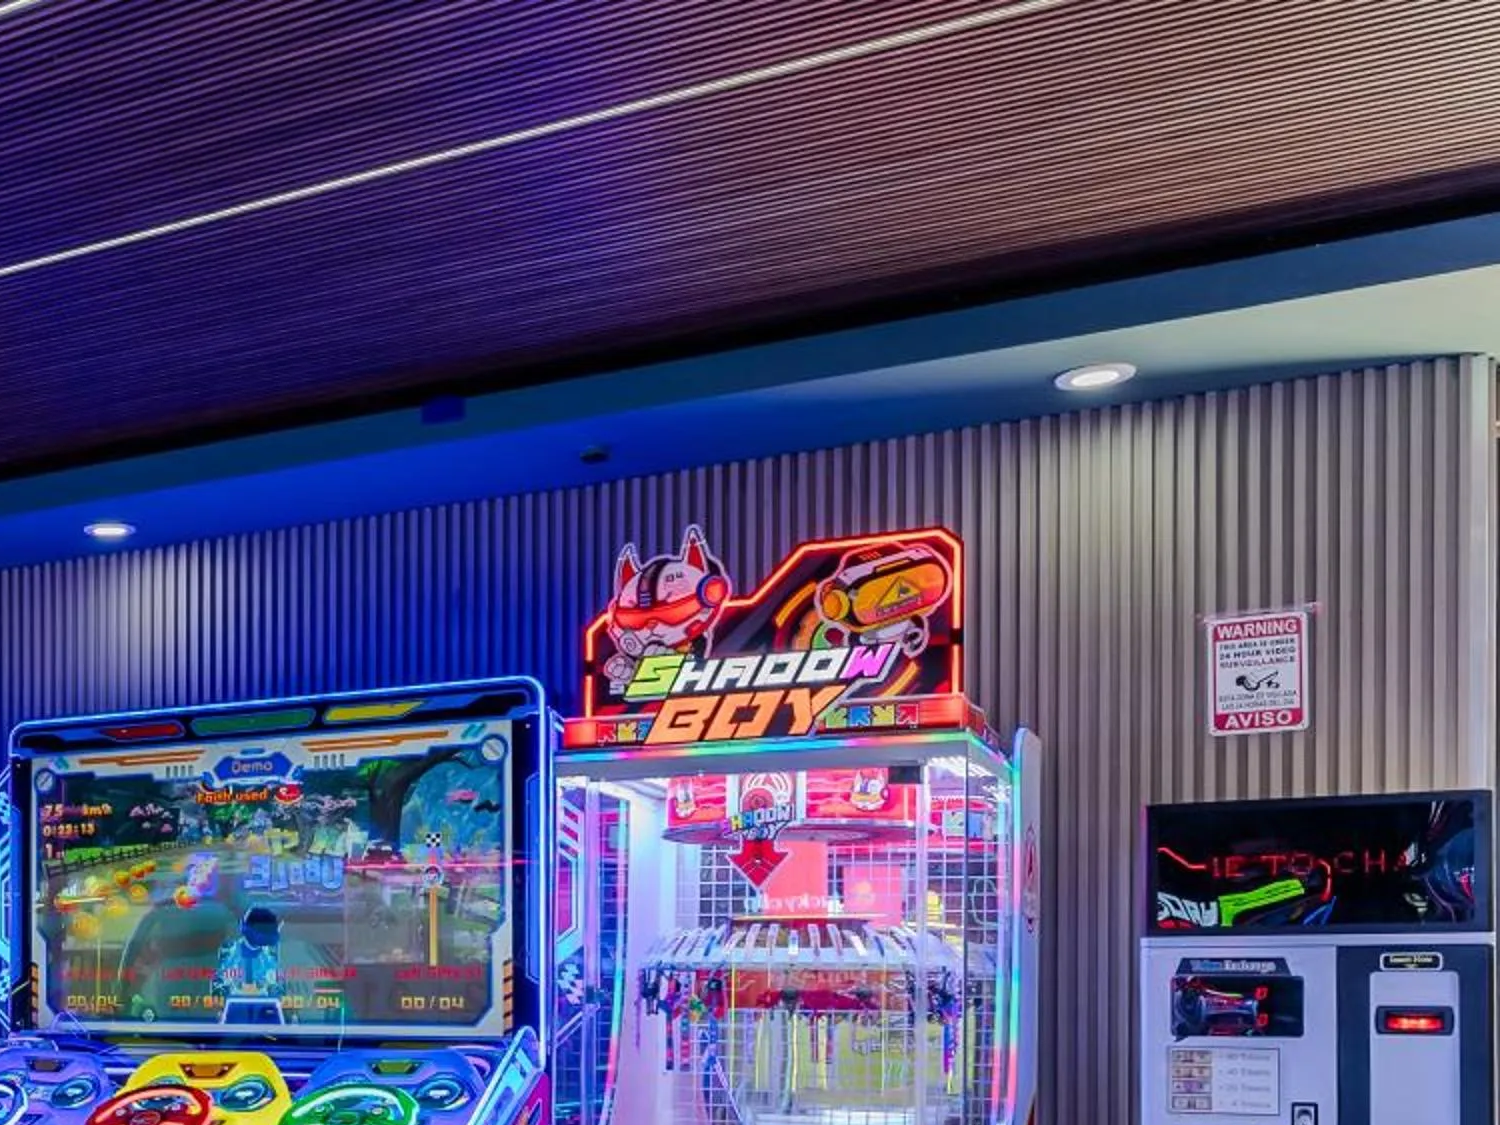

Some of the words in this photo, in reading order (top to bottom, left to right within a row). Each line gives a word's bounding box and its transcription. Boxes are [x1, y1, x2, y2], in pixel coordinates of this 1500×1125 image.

[1217, 620, 1297, 638] WARNING
[1266, 646, 1296, 656] VIDEO
[625, 643, 896, 700] SHADOW
[645, 685, 848, 744] BOY
[1225, 711, 1293, 729] AVISO
[232, 761, 273, 774] Demo
